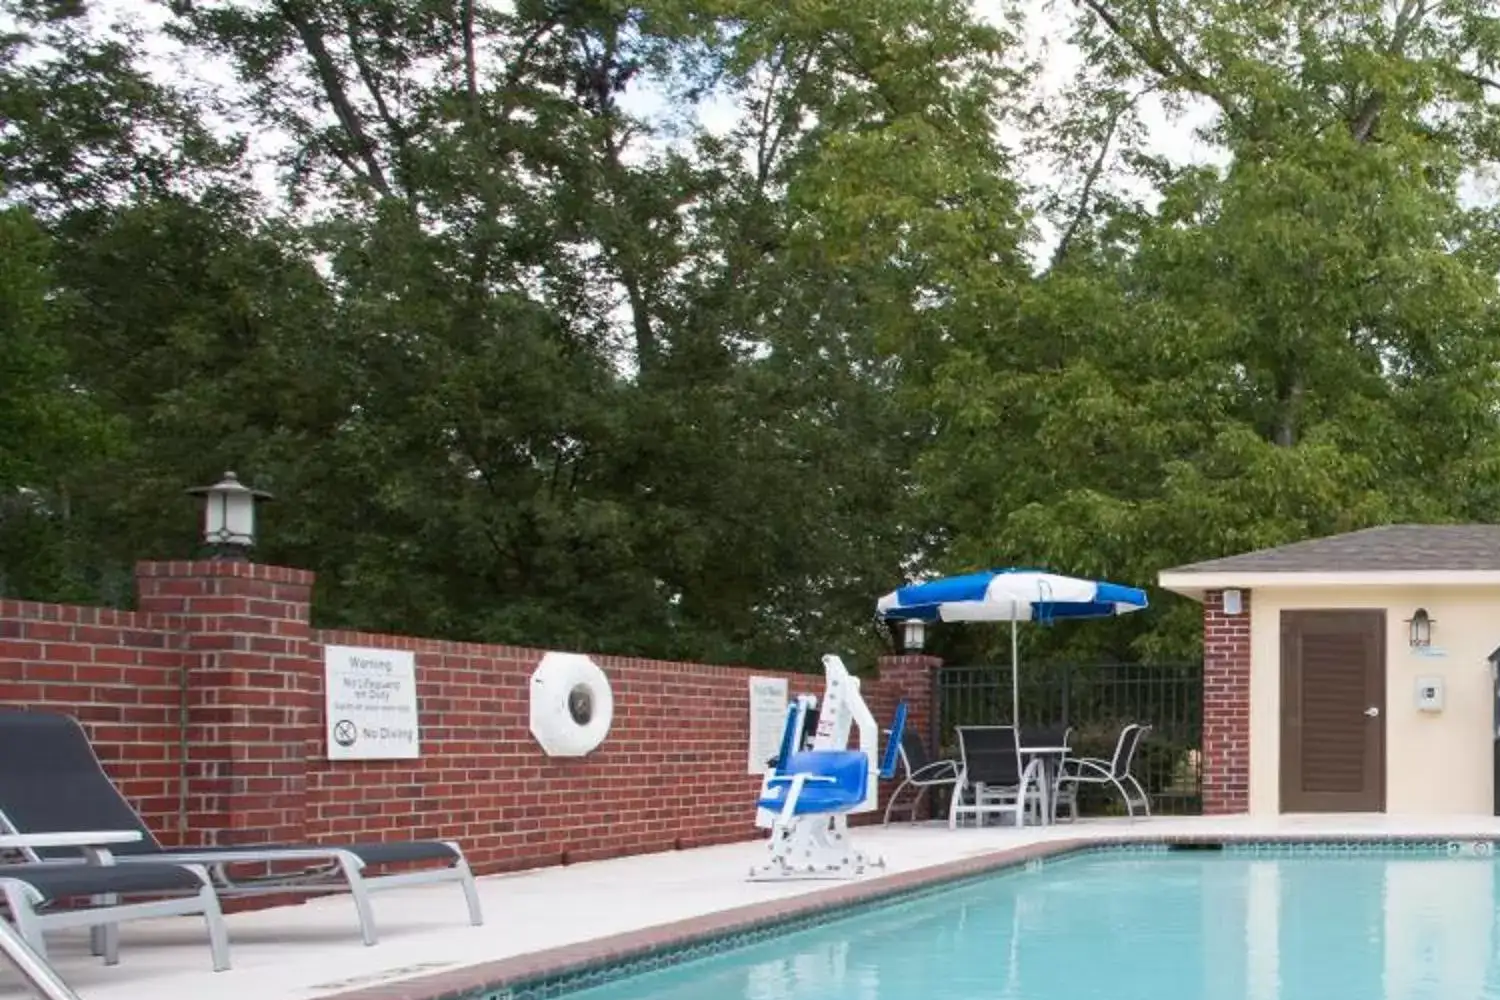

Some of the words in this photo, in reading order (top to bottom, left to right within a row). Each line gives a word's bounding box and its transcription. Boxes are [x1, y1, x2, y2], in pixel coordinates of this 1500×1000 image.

[349, 656, 393, 672] Warning
[343, 677, 356, 689] No
[368, 689, 390, 702] Duty
[363, 727, 378, 739] No
[380, 727, 414, 744] Diving
